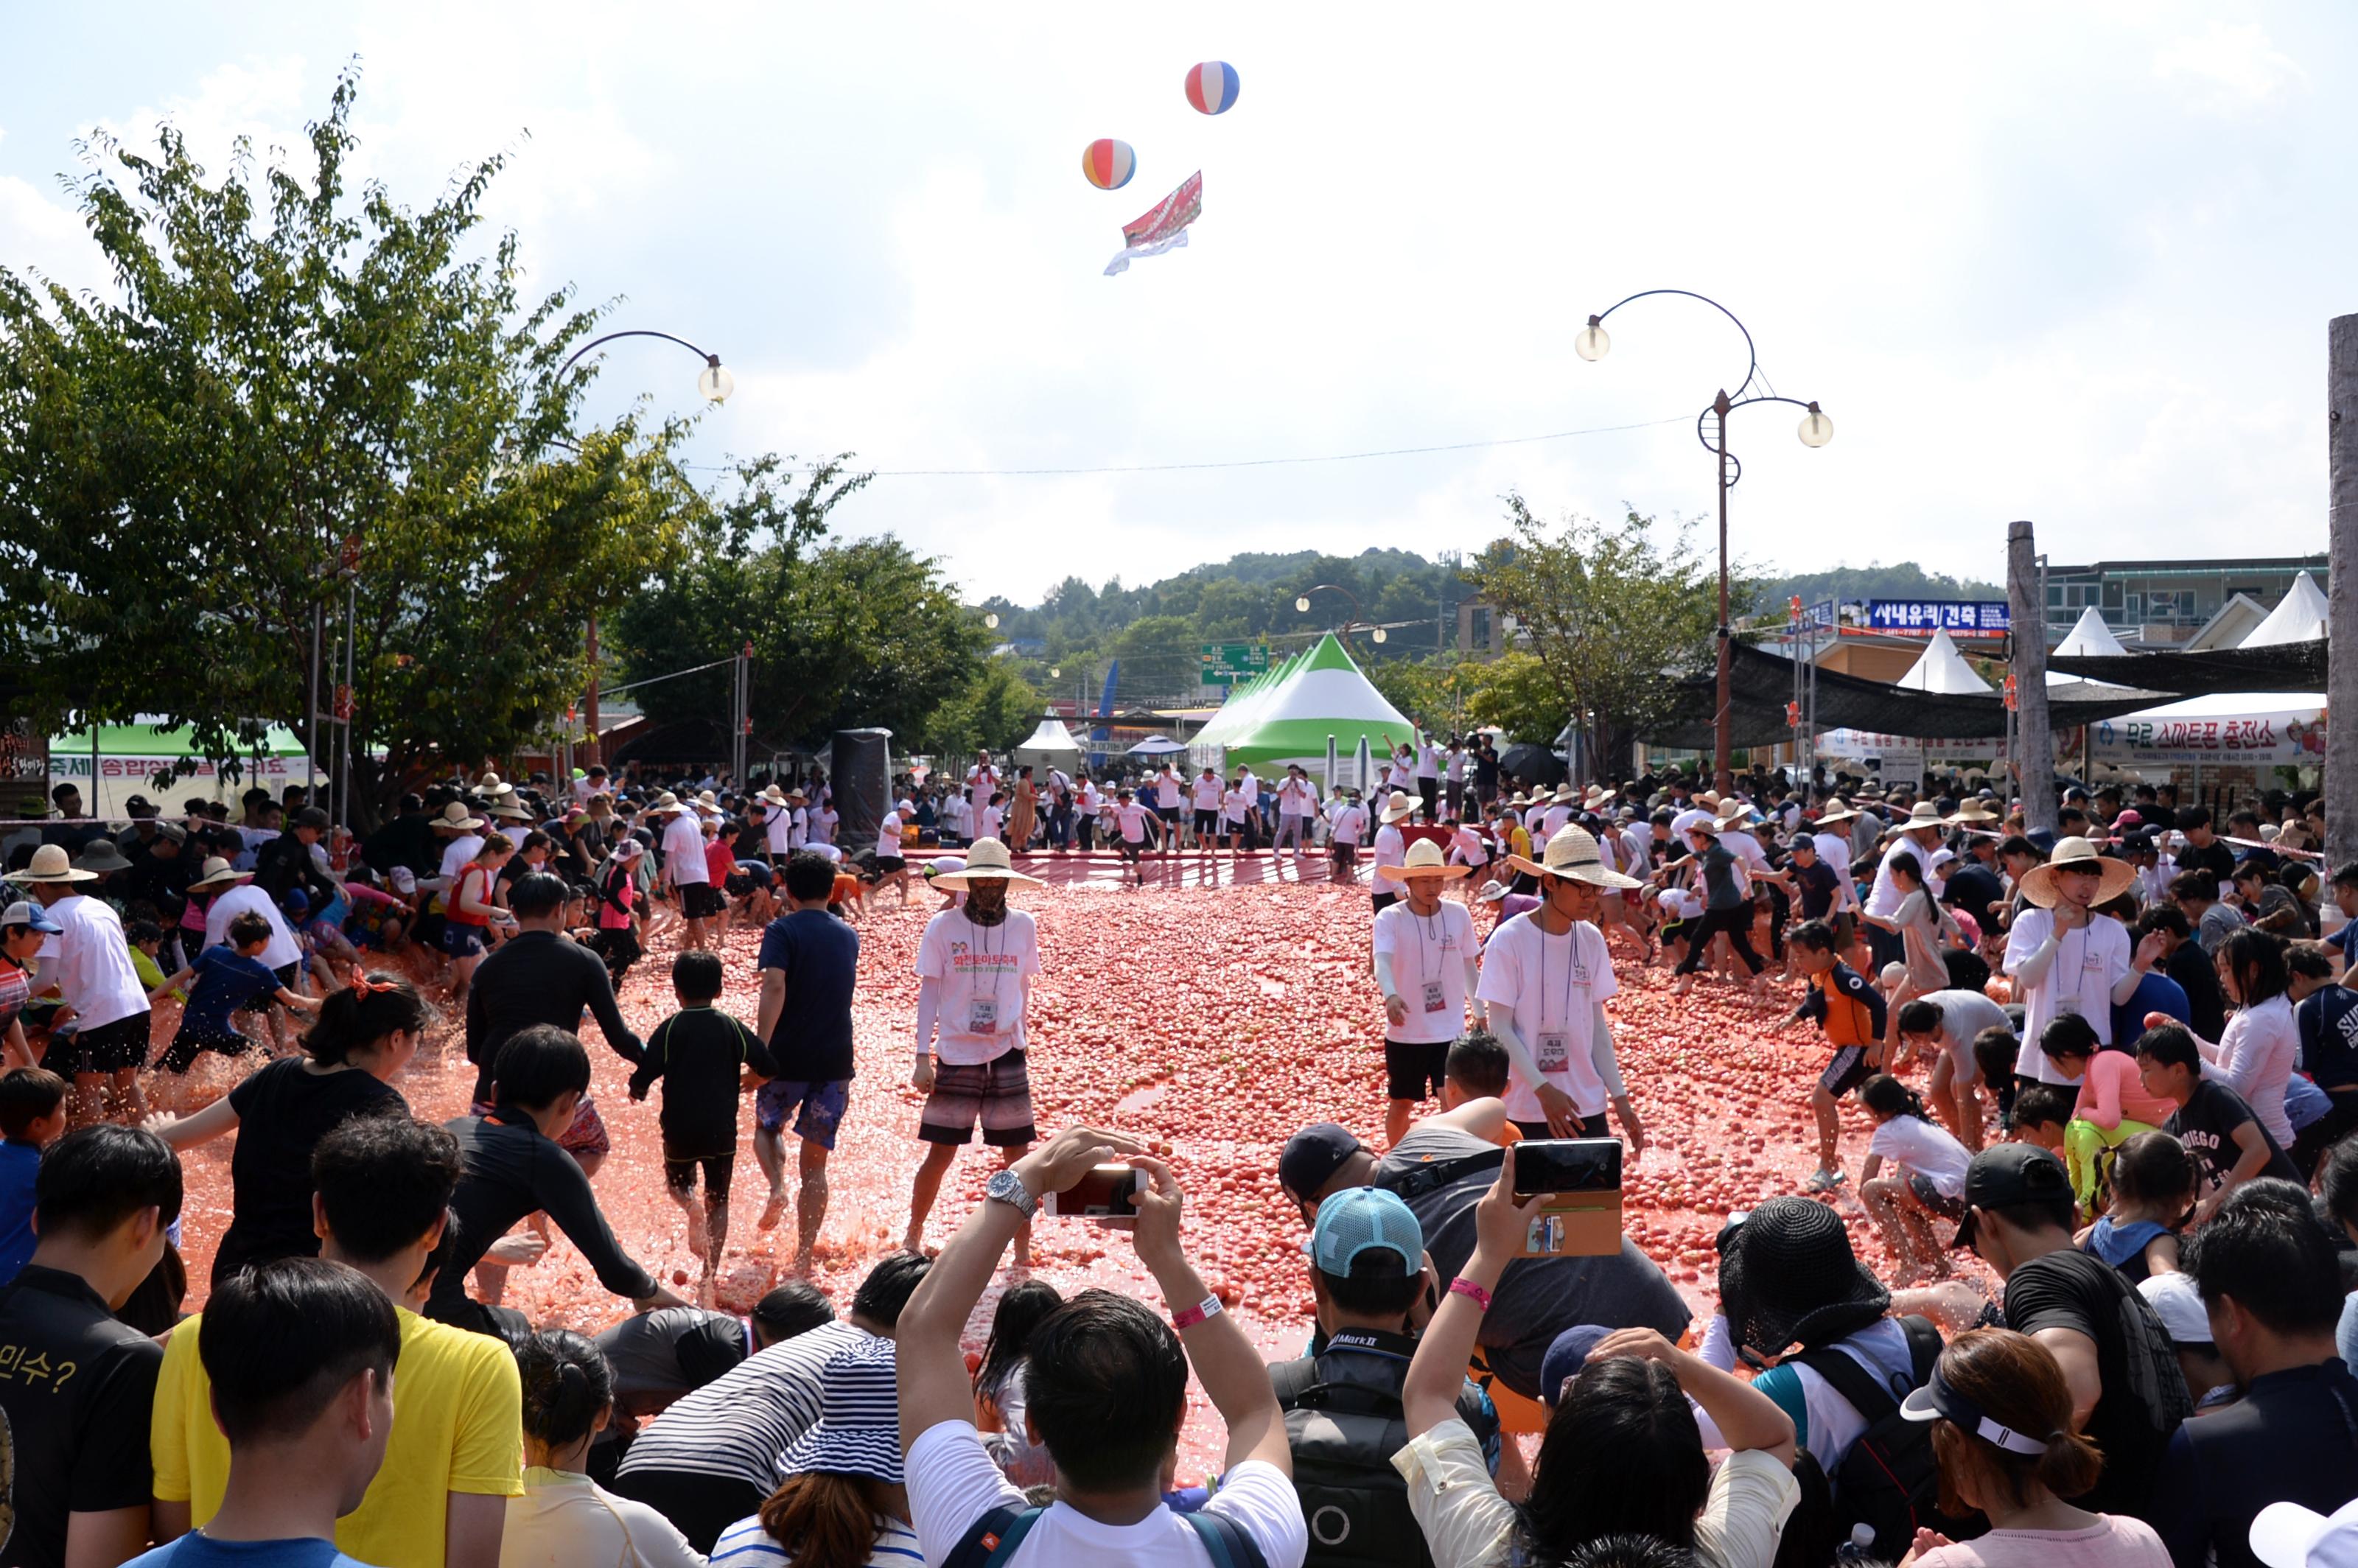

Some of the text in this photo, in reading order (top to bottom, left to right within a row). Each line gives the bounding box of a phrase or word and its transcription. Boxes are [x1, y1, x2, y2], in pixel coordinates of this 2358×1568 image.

[1875, 604, 1976, 626] 사내유리/건축
[2127, 720, 2277, 749] 무료 스마트폰 충전소
